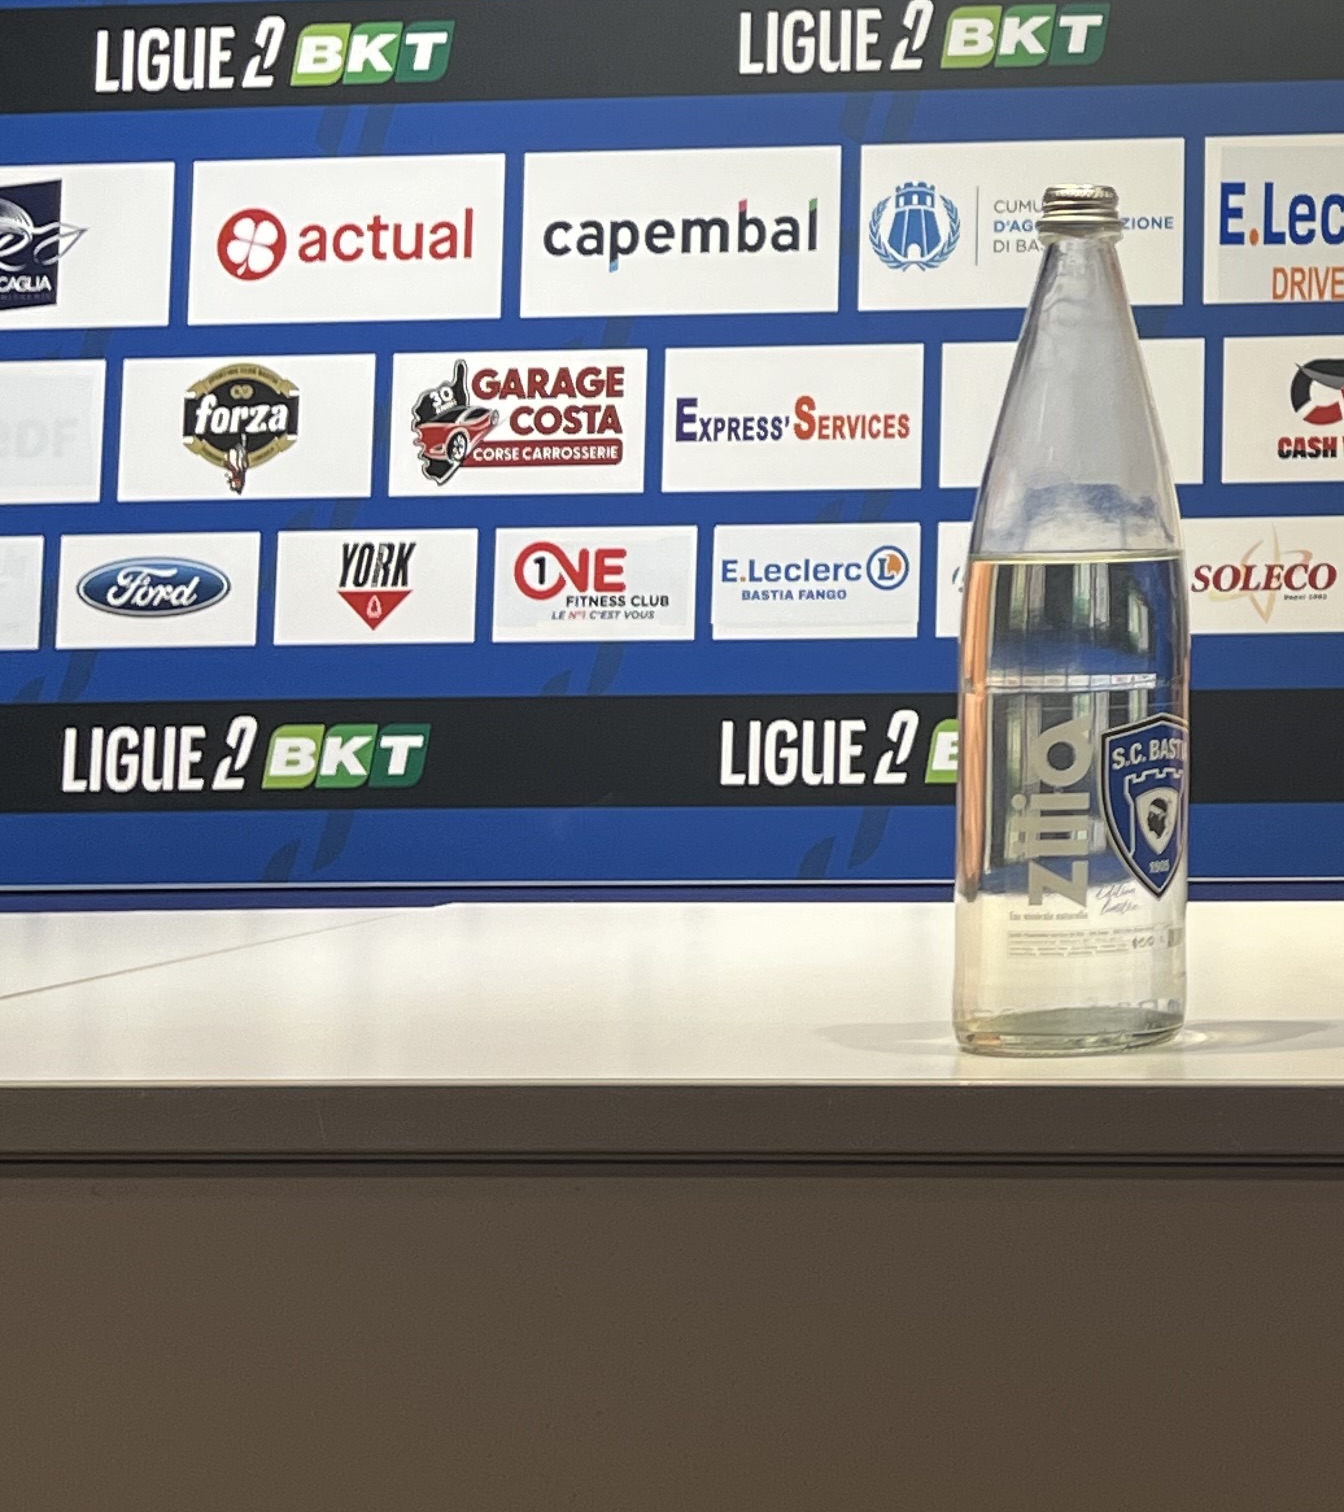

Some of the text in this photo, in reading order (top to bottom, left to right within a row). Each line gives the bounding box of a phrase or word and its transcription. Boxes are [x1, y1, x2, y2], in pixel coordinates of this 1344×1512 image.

[739, 9, 881, 74] LIGUE
[947, 12, 1102, 59] BKT
[95, 27, 235, 92] LIGUE
[299, 29, 448, 73] BKT
[299, 208, 473, 262] actual
[544, 199, 817, 272] capembal
[1273, 268, 1344, 299] DRIVE
[472, 367, 624, 400] GARAGE
[193, 400, 289, 434] forza
[510, 405, 622, 435] COSTA
[473, 446, 617, 461] CORSE CARROSSERIE
[1278, 437, 1337, 459] CASH
[340, 543, 416, 587] YORK
[721, 555, 862, 584] E.Leclerc
[1192, 563, 1336, 592] SOLECO
[105, 563, 197, 607] Ford
[567, 595, 669, 607] FITNESS CLUB
[742, 590, 847, 600] BASTIA FANGO
[62, 726, 205, 792] LIGUE
[270, 734, 424, 776] BKT
[721, 720, 866, 785] LIGUE
